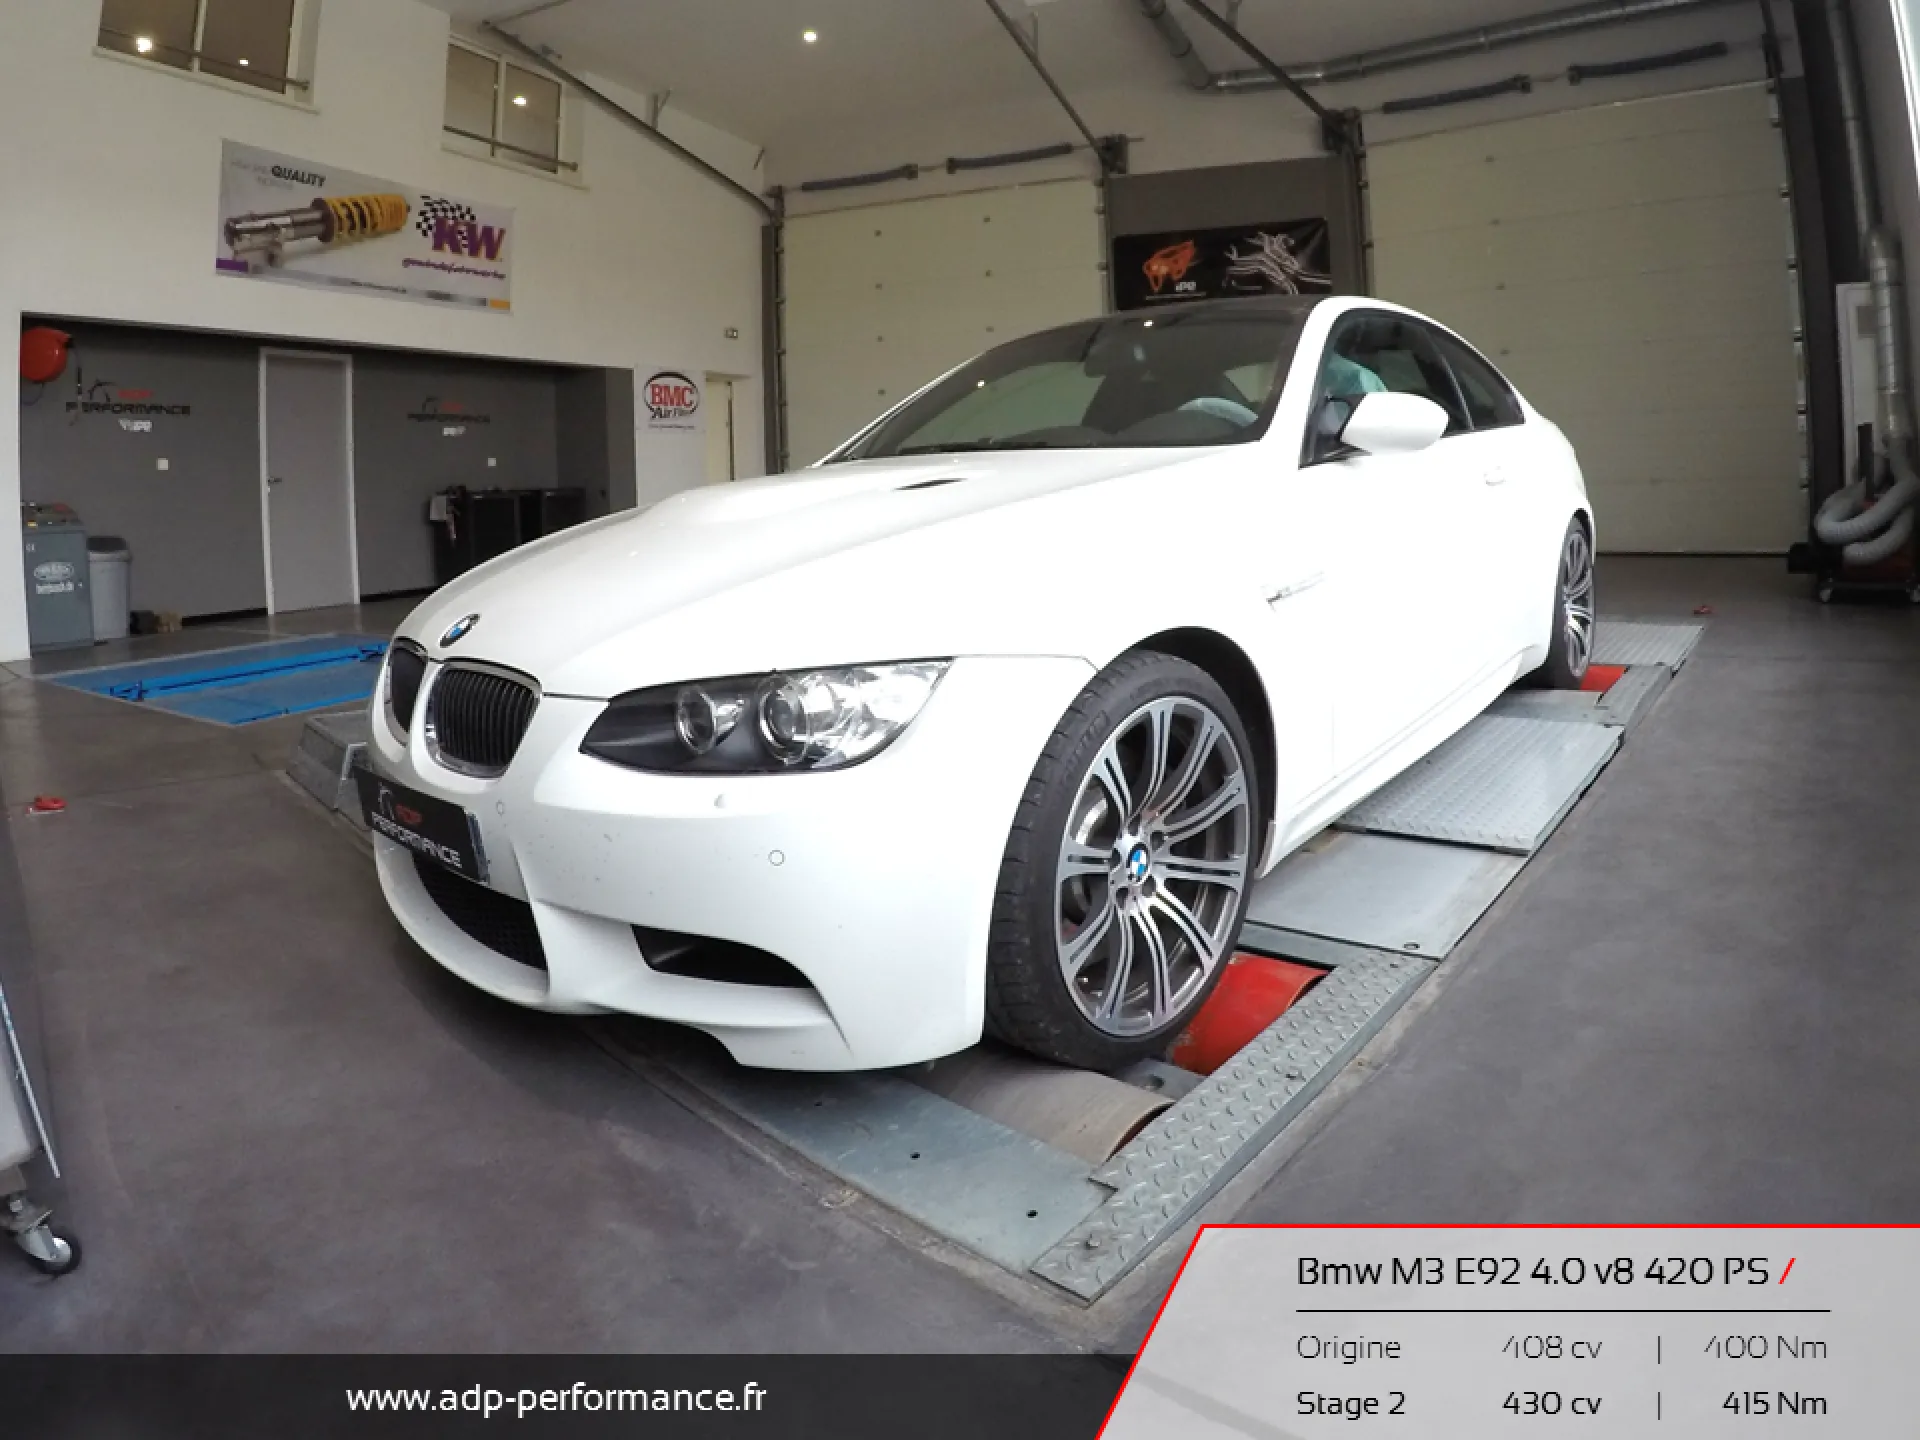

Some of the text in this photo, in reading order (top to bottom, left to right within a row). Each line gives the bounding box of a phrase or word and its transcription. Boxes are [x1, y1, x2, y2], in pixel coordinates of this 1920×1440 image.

[271, 165, 326, 187] QUALITY
[431, 217, 506, 261] KW
[650, 384, 694, 408] BMC
[371, 811, 463, 869] PERFORMANCE
